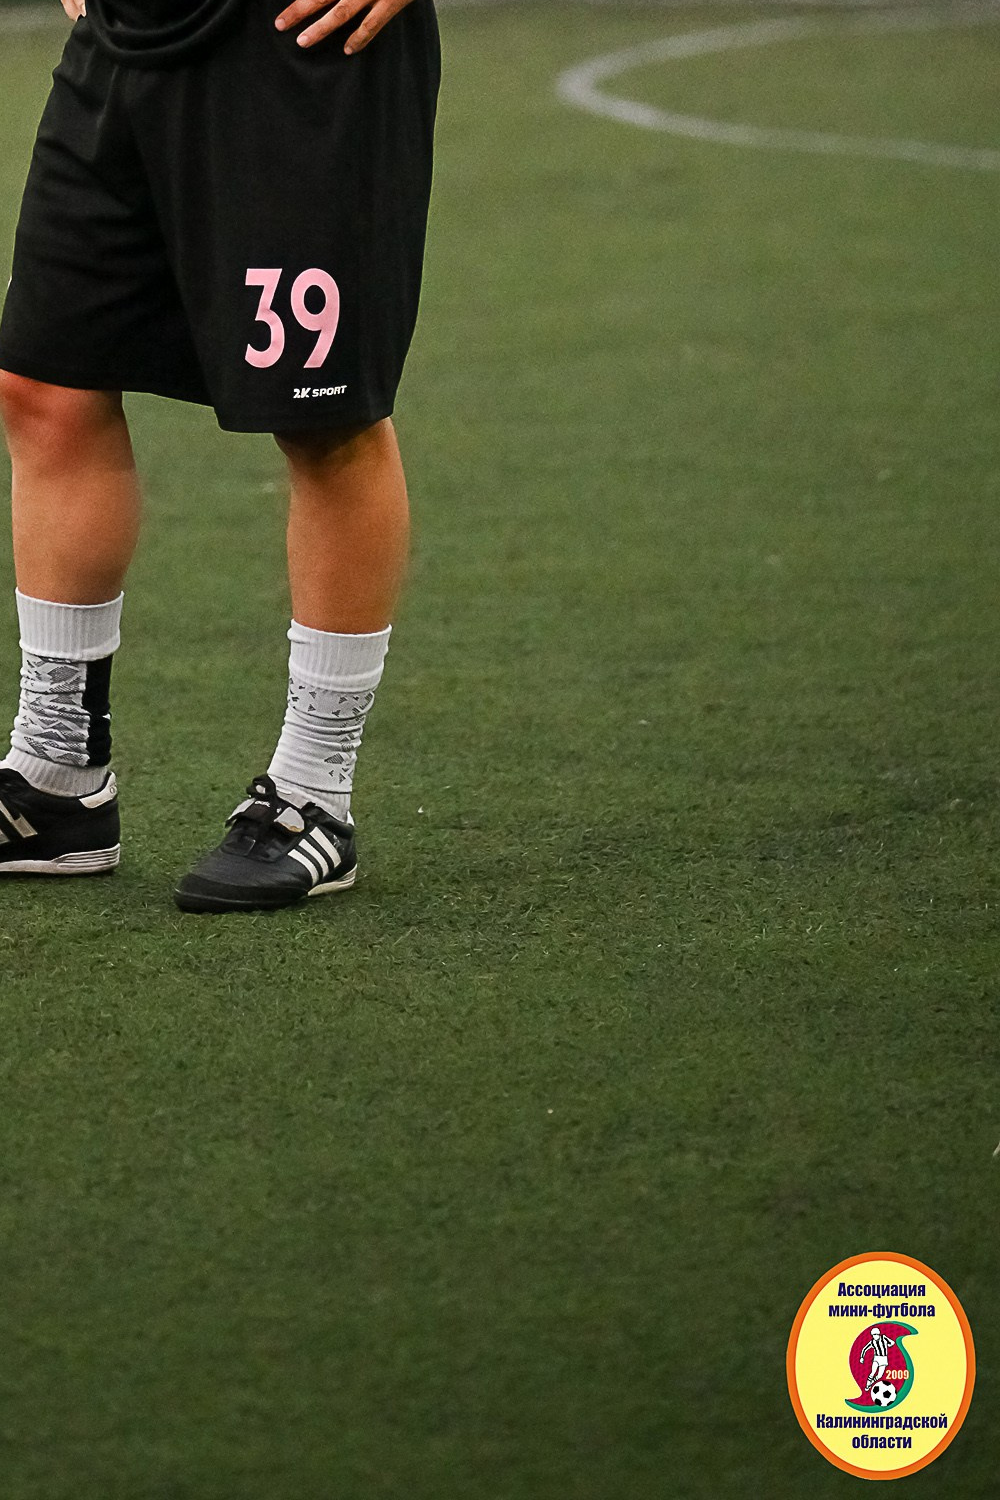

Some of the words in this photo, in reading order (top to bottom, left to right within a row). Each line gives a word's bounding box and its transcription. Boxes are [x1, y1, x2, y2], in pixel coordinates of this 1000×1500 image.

[244, 267, 341, 369] 39
[293, 387, 311, 399] 2K
[311, 384, 348, 398] SPORT
